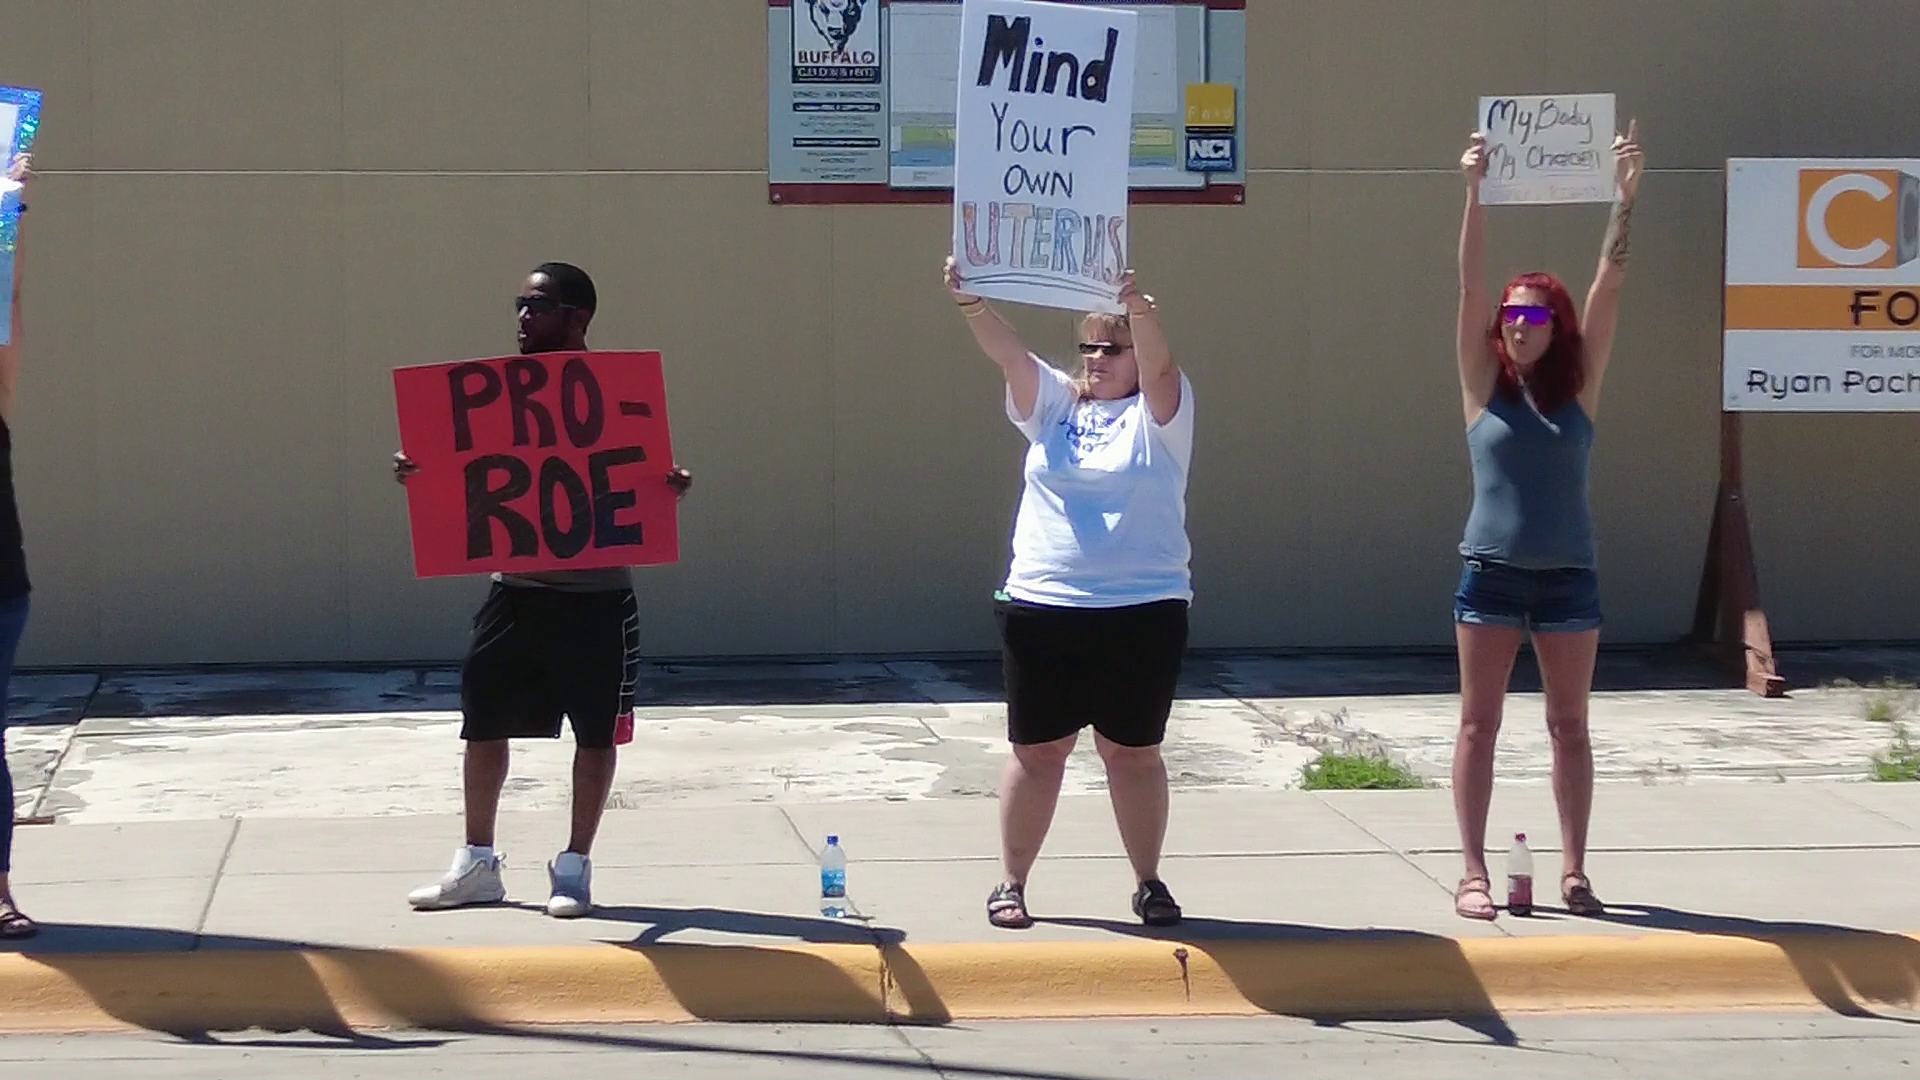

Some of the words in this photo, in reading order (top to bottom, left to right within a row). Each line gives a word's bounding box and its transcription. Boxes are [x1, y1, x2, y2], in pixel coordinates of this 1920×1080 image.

[798, 51, 875, 64] BUFFALO
[976, 14, 1119, 103] Mind
[991, 102, 1095, 155] Your
[1487, 99, 1532, 145] My
[1534, 98, 1593, 144] Body
[1189, 139, 1230, 159] NCI
[1487, 143, 1516, 180] My
[1004, 164, 1073, 198] OWN
[1806, 173, 1892, 266] C
[962, 201, 1125, 286] UTERUS
[1851, 290, 1919, 326] FO
[1851, 345, 1885, 359] FOR
[448, 357, 652, 452] PRO-
[1747, 369, 1831, 399] Ryan
[464, 445, 646, 559] ROE
